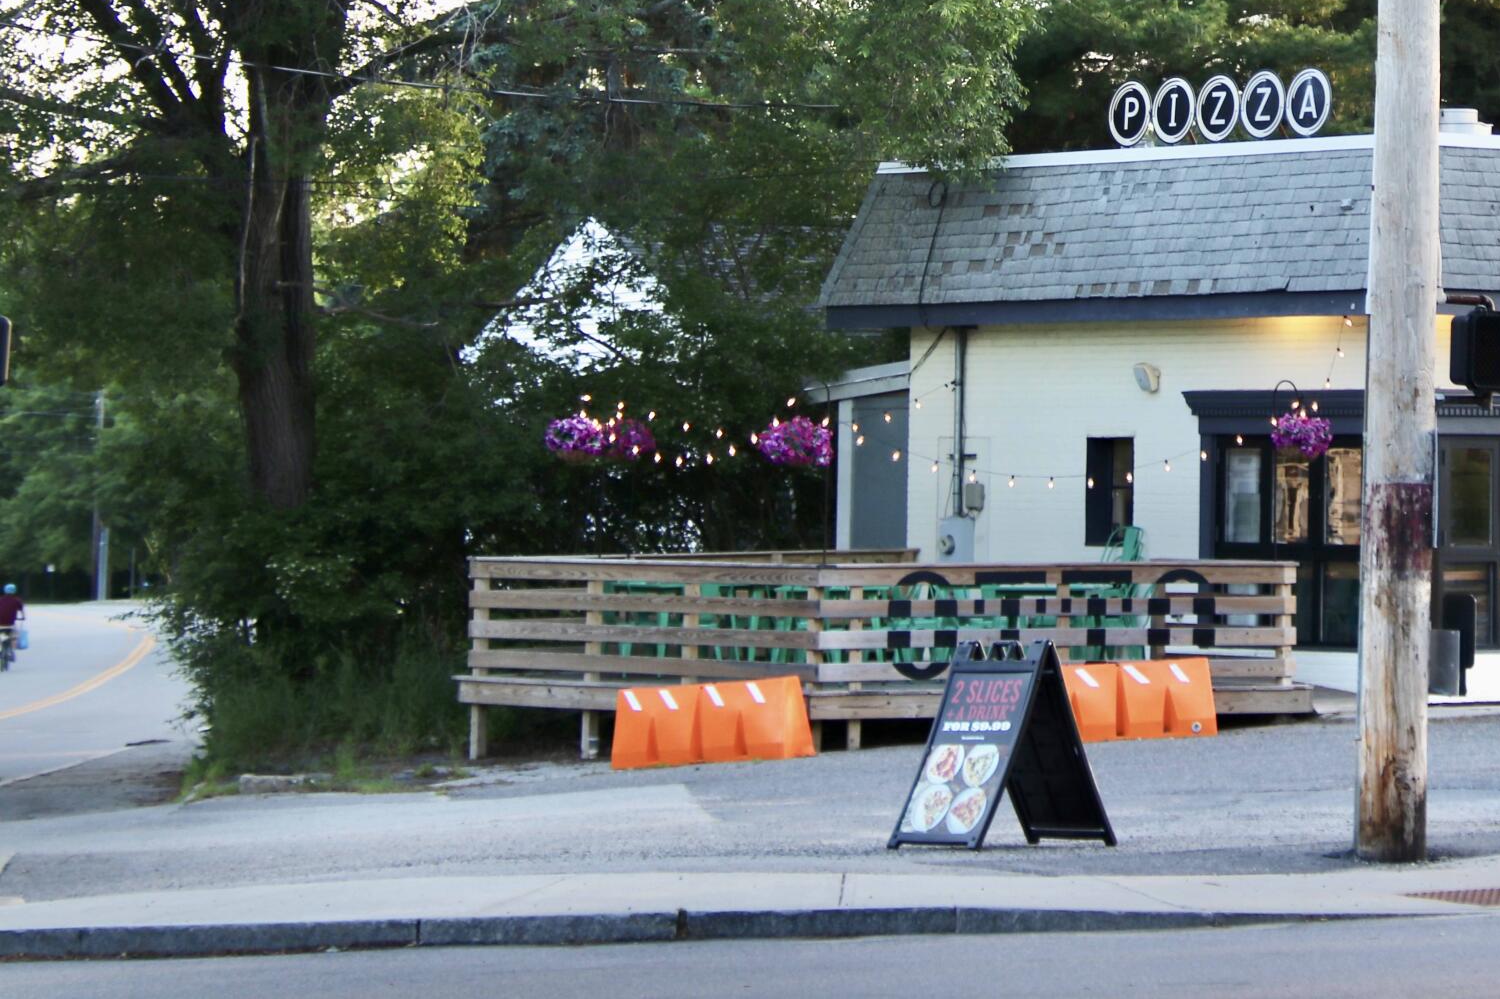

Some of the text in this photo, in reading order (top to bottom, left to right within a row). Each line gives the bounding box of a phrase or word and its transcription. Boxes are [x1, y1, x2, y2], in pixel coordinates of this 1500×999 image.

[1121, 82, 1320, 133] PIZZA
[951, 678, 1024, 704] 2 SLICES
[942, 721, 971, 732] FOR
